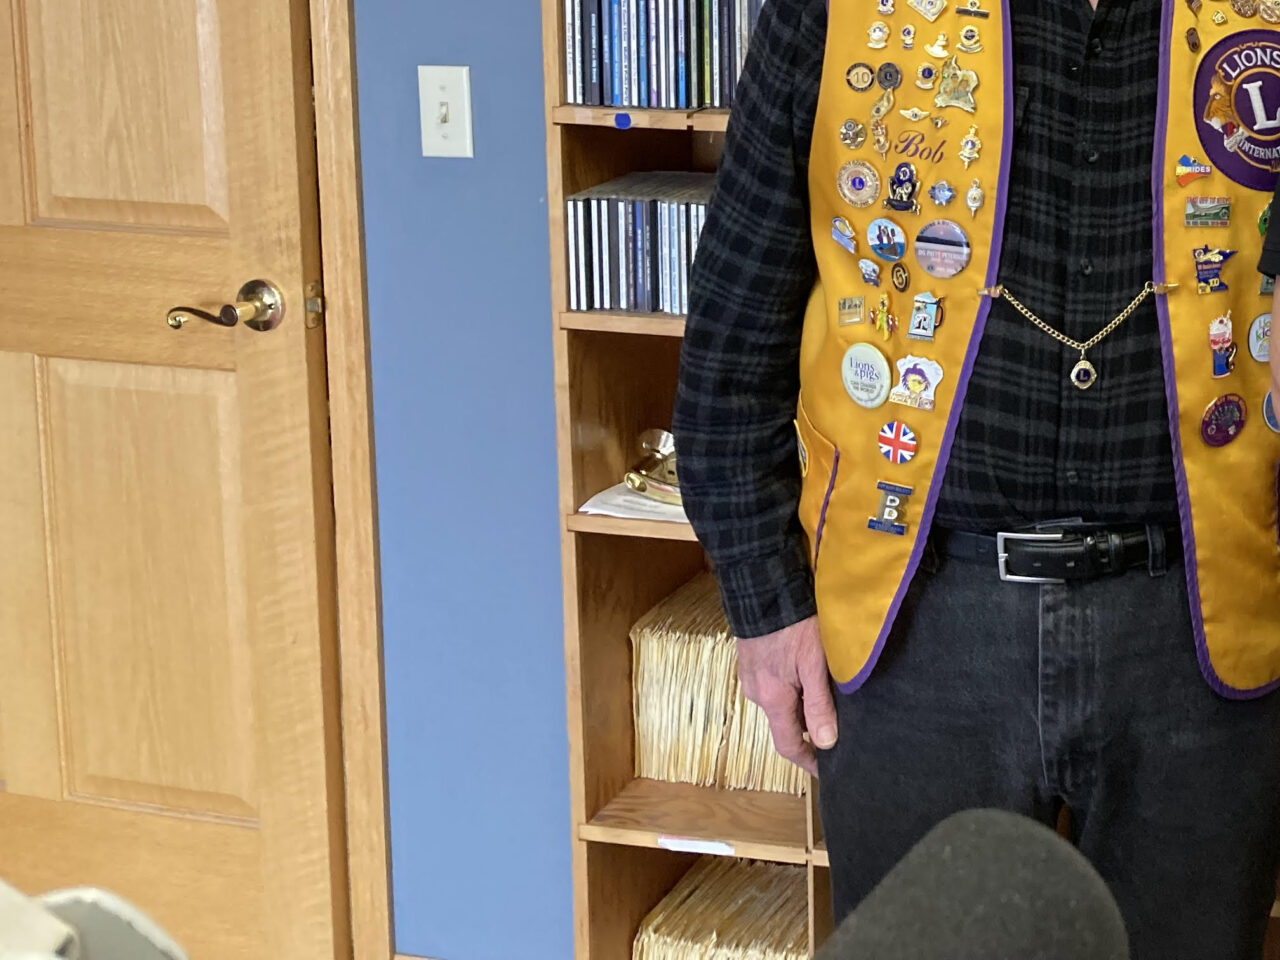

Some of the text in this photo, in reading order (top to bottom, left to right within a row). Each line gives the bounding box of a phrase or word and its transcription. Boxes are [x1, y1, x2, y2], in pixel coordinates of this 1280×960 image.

[853, 71, 870, 84] 10
[894, 129, 947, 164] Bob
[850, 357, 875, 373] Lions
